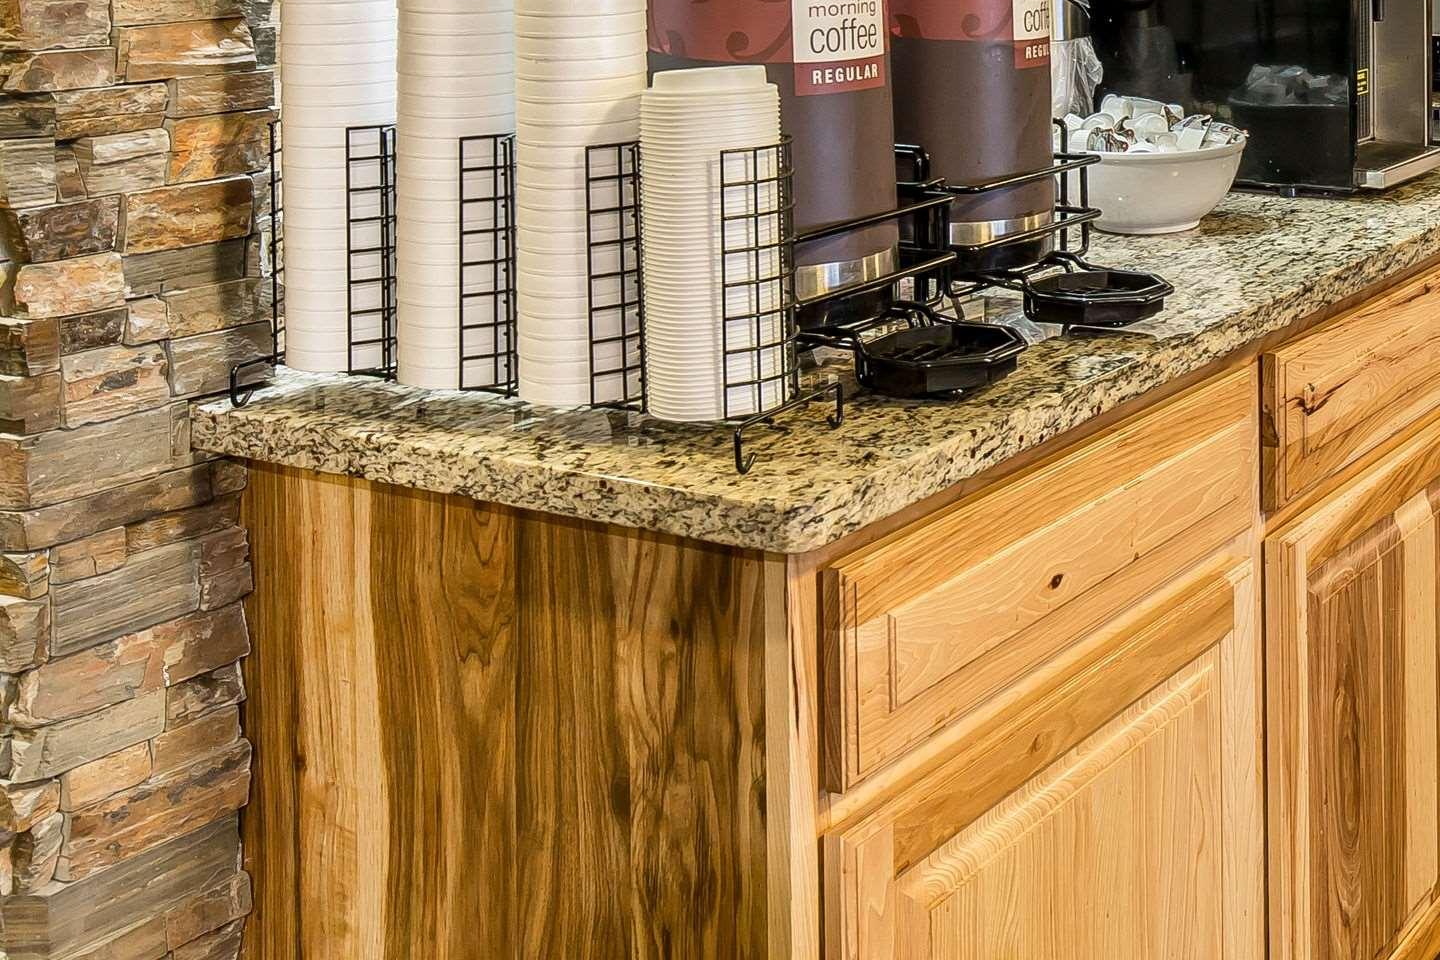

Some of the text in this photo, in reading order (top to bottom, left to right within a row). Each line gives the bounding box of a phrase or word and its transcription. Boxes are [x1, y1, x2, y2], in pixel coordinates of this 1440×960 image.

[808, 0, 876, 18] morning
[810, 17, 877, 54] coffee
[812, 63, 879, 86] REGULAR
